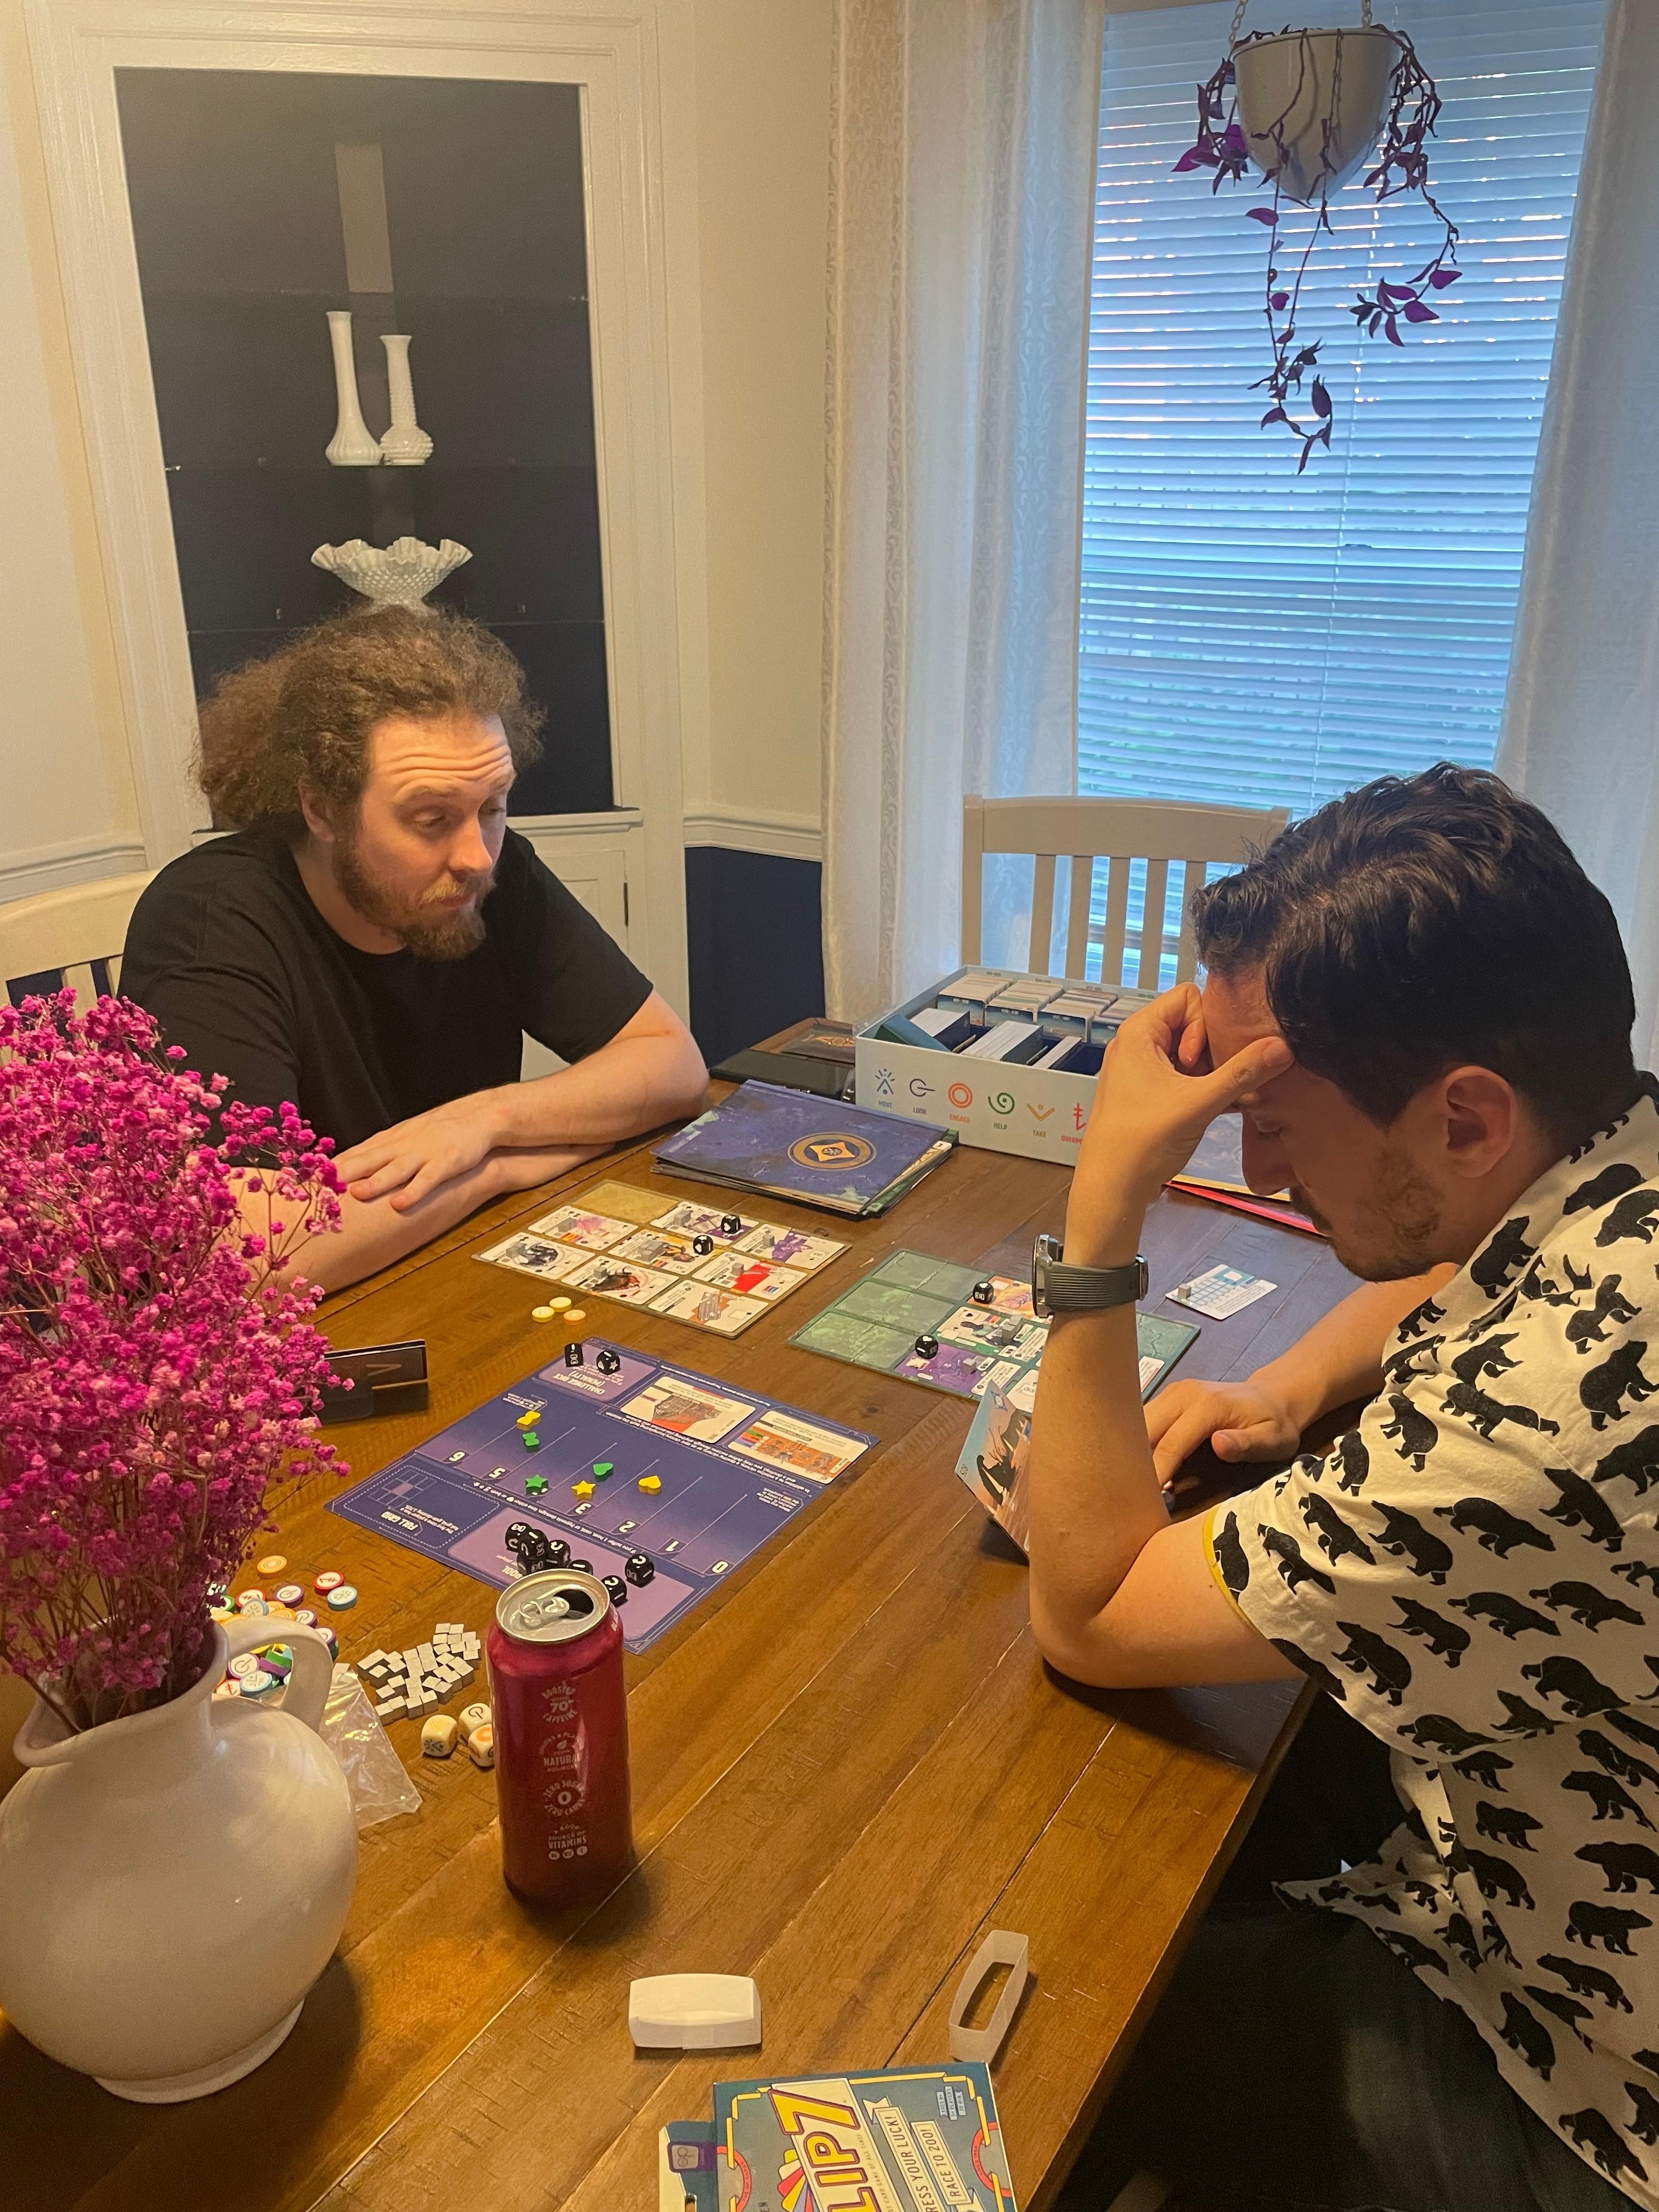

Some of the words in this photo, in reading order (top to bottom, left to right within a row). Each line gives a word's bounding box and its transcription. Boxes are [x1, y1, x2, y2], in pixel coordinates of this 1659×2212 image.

[913, 1107, 927, 1115] LOOK
[949, 1114, 970, 1124] ENGAGE
[1033, 1130, 1046, 1138] TAKE
[449, 1451, 466, 1462] 6
[489, 1468, 506, 1479] 5
[575, 1503, 591, 1514] 3
[381, 1511, 401, 1522] GRID
[398, 1519, 418, 1530] FULL
[618, 1521, 636, 1532] 2
[665, 1541, 680, 1553] 1
[712, 1561, 729, 1573] 0
[549, 1835, 587, 1849] VITAMINS
[884, 2116, 909, 2148] LUCK!
[921, 2129, 940, 2152] 200!
[901, 2151, 924, 2181] YOUR
[933, 2155, 947, 2168] TO
[939, 2170, 961, 2197] RACE
